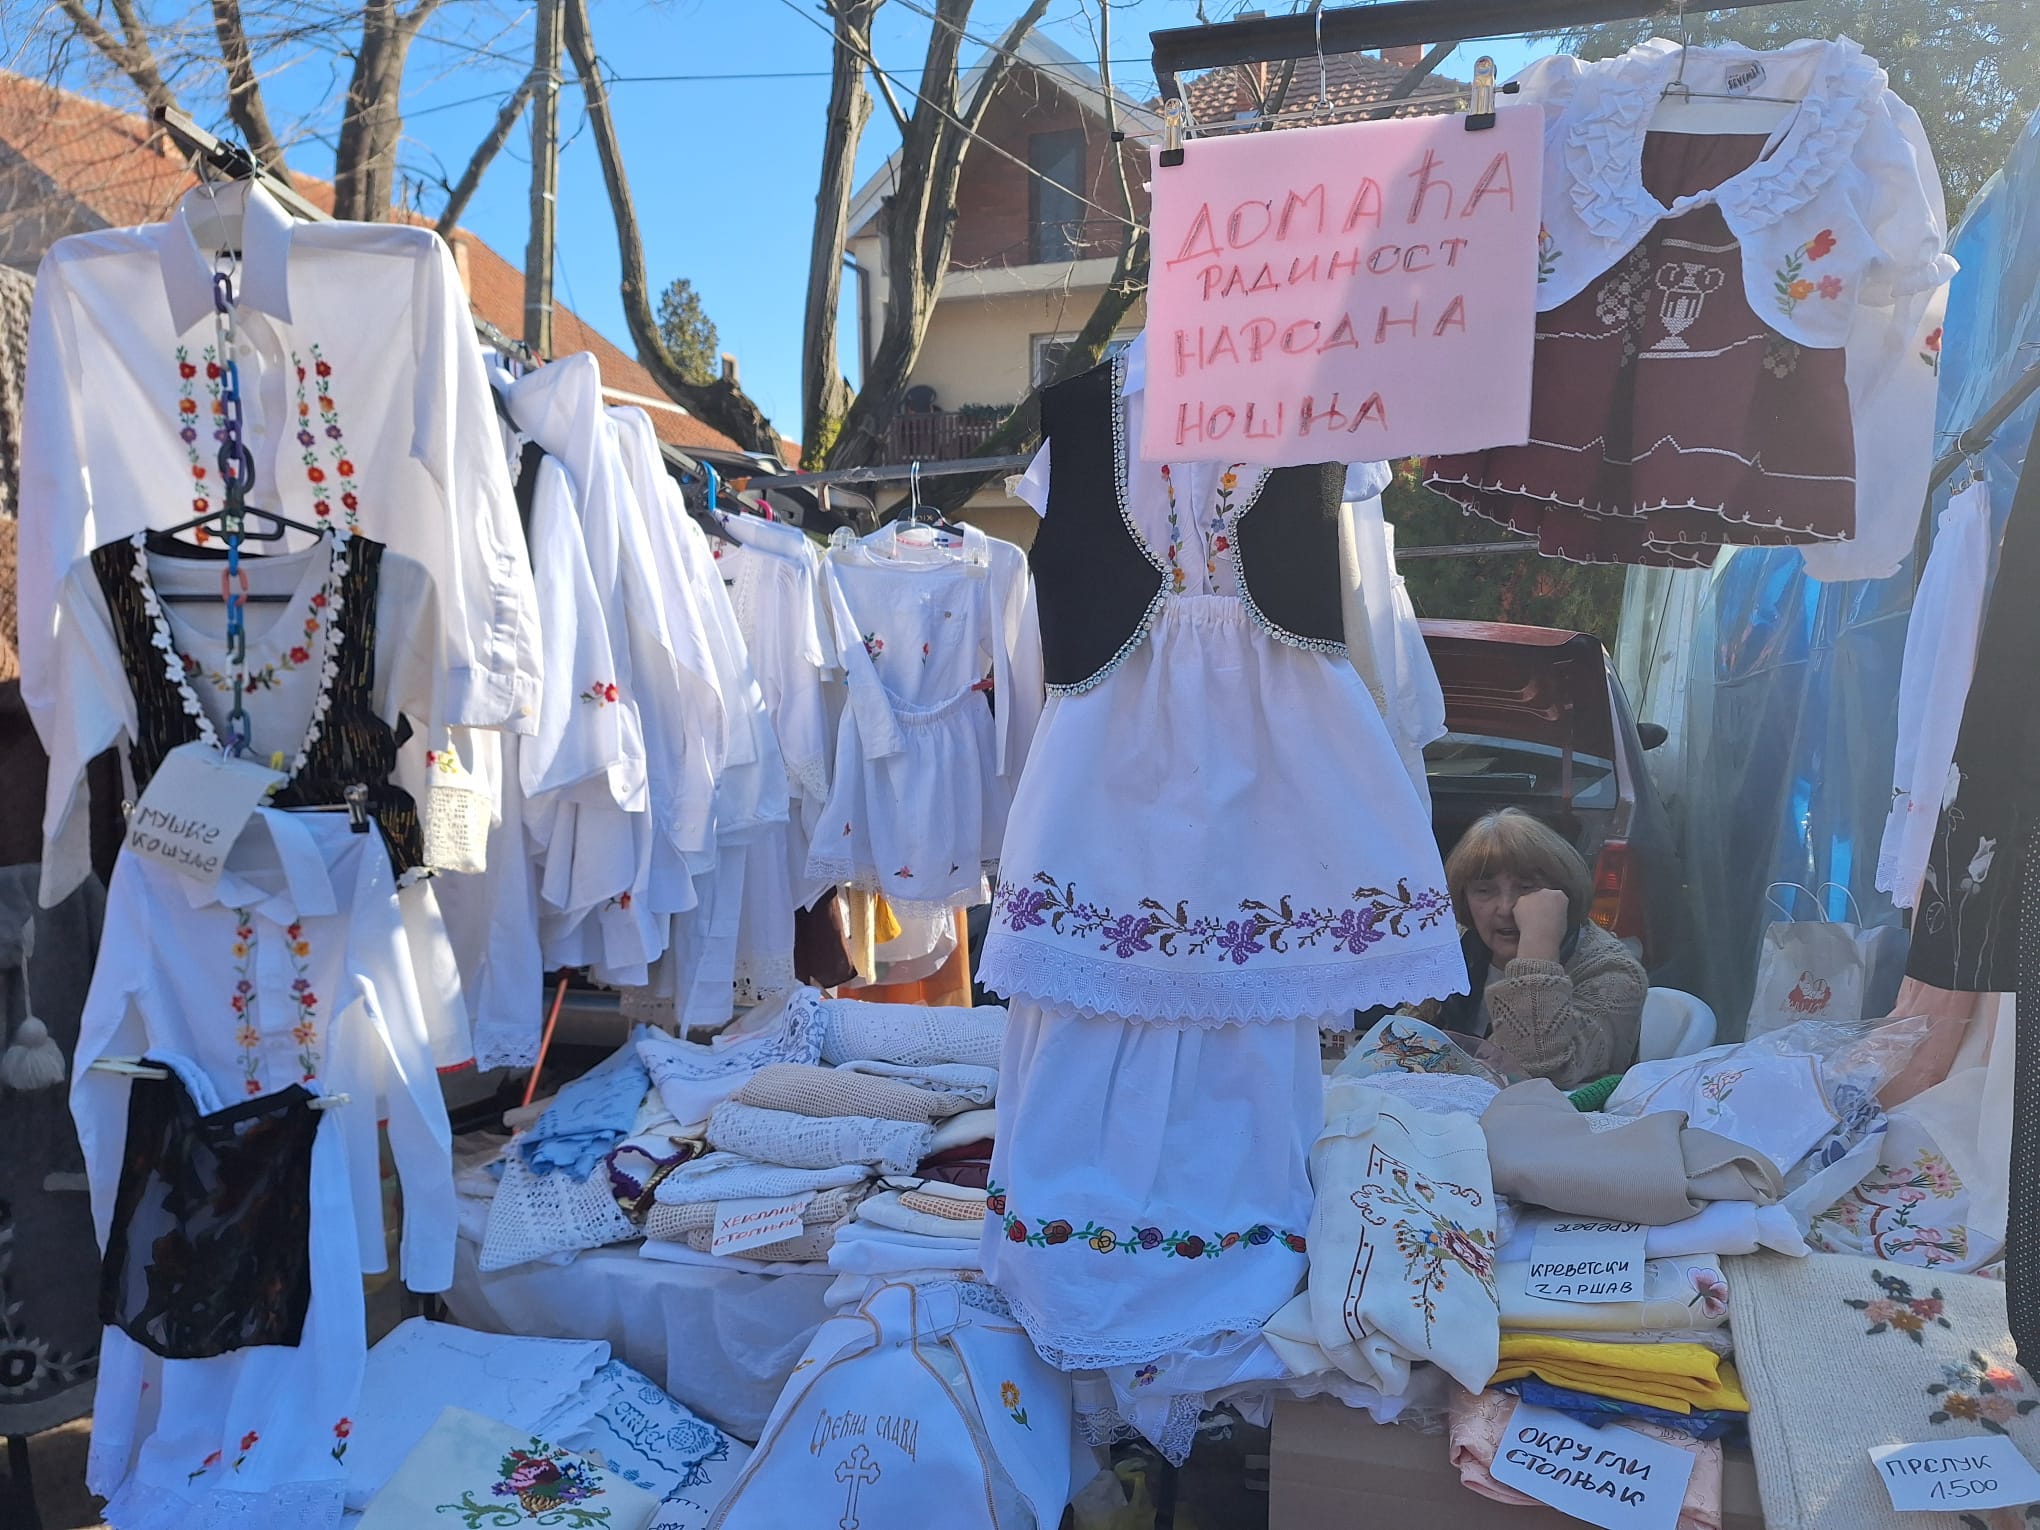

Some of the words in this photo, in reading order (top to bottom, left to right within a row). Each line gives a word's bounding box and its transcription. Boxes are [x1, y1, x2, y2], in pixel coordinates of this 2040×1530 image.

[1166, 149, 1514, 271] ДОМАЋА
[1197, 238, 1468, 301] РАДИНОСТ
[1174, 294, 1467, 377] НАРОДНА
[1175, 391, 1389, 445] НОШЊА
[1506, 1449, 1646, 1507] СТОЛЊАК
[1518, 1427, 1651, 1480] ОКРУГЛИ
[1885, 1455, 1992, 1477] ПРСЛУК
[1930, 1479, 1998, 1500] 1.500
